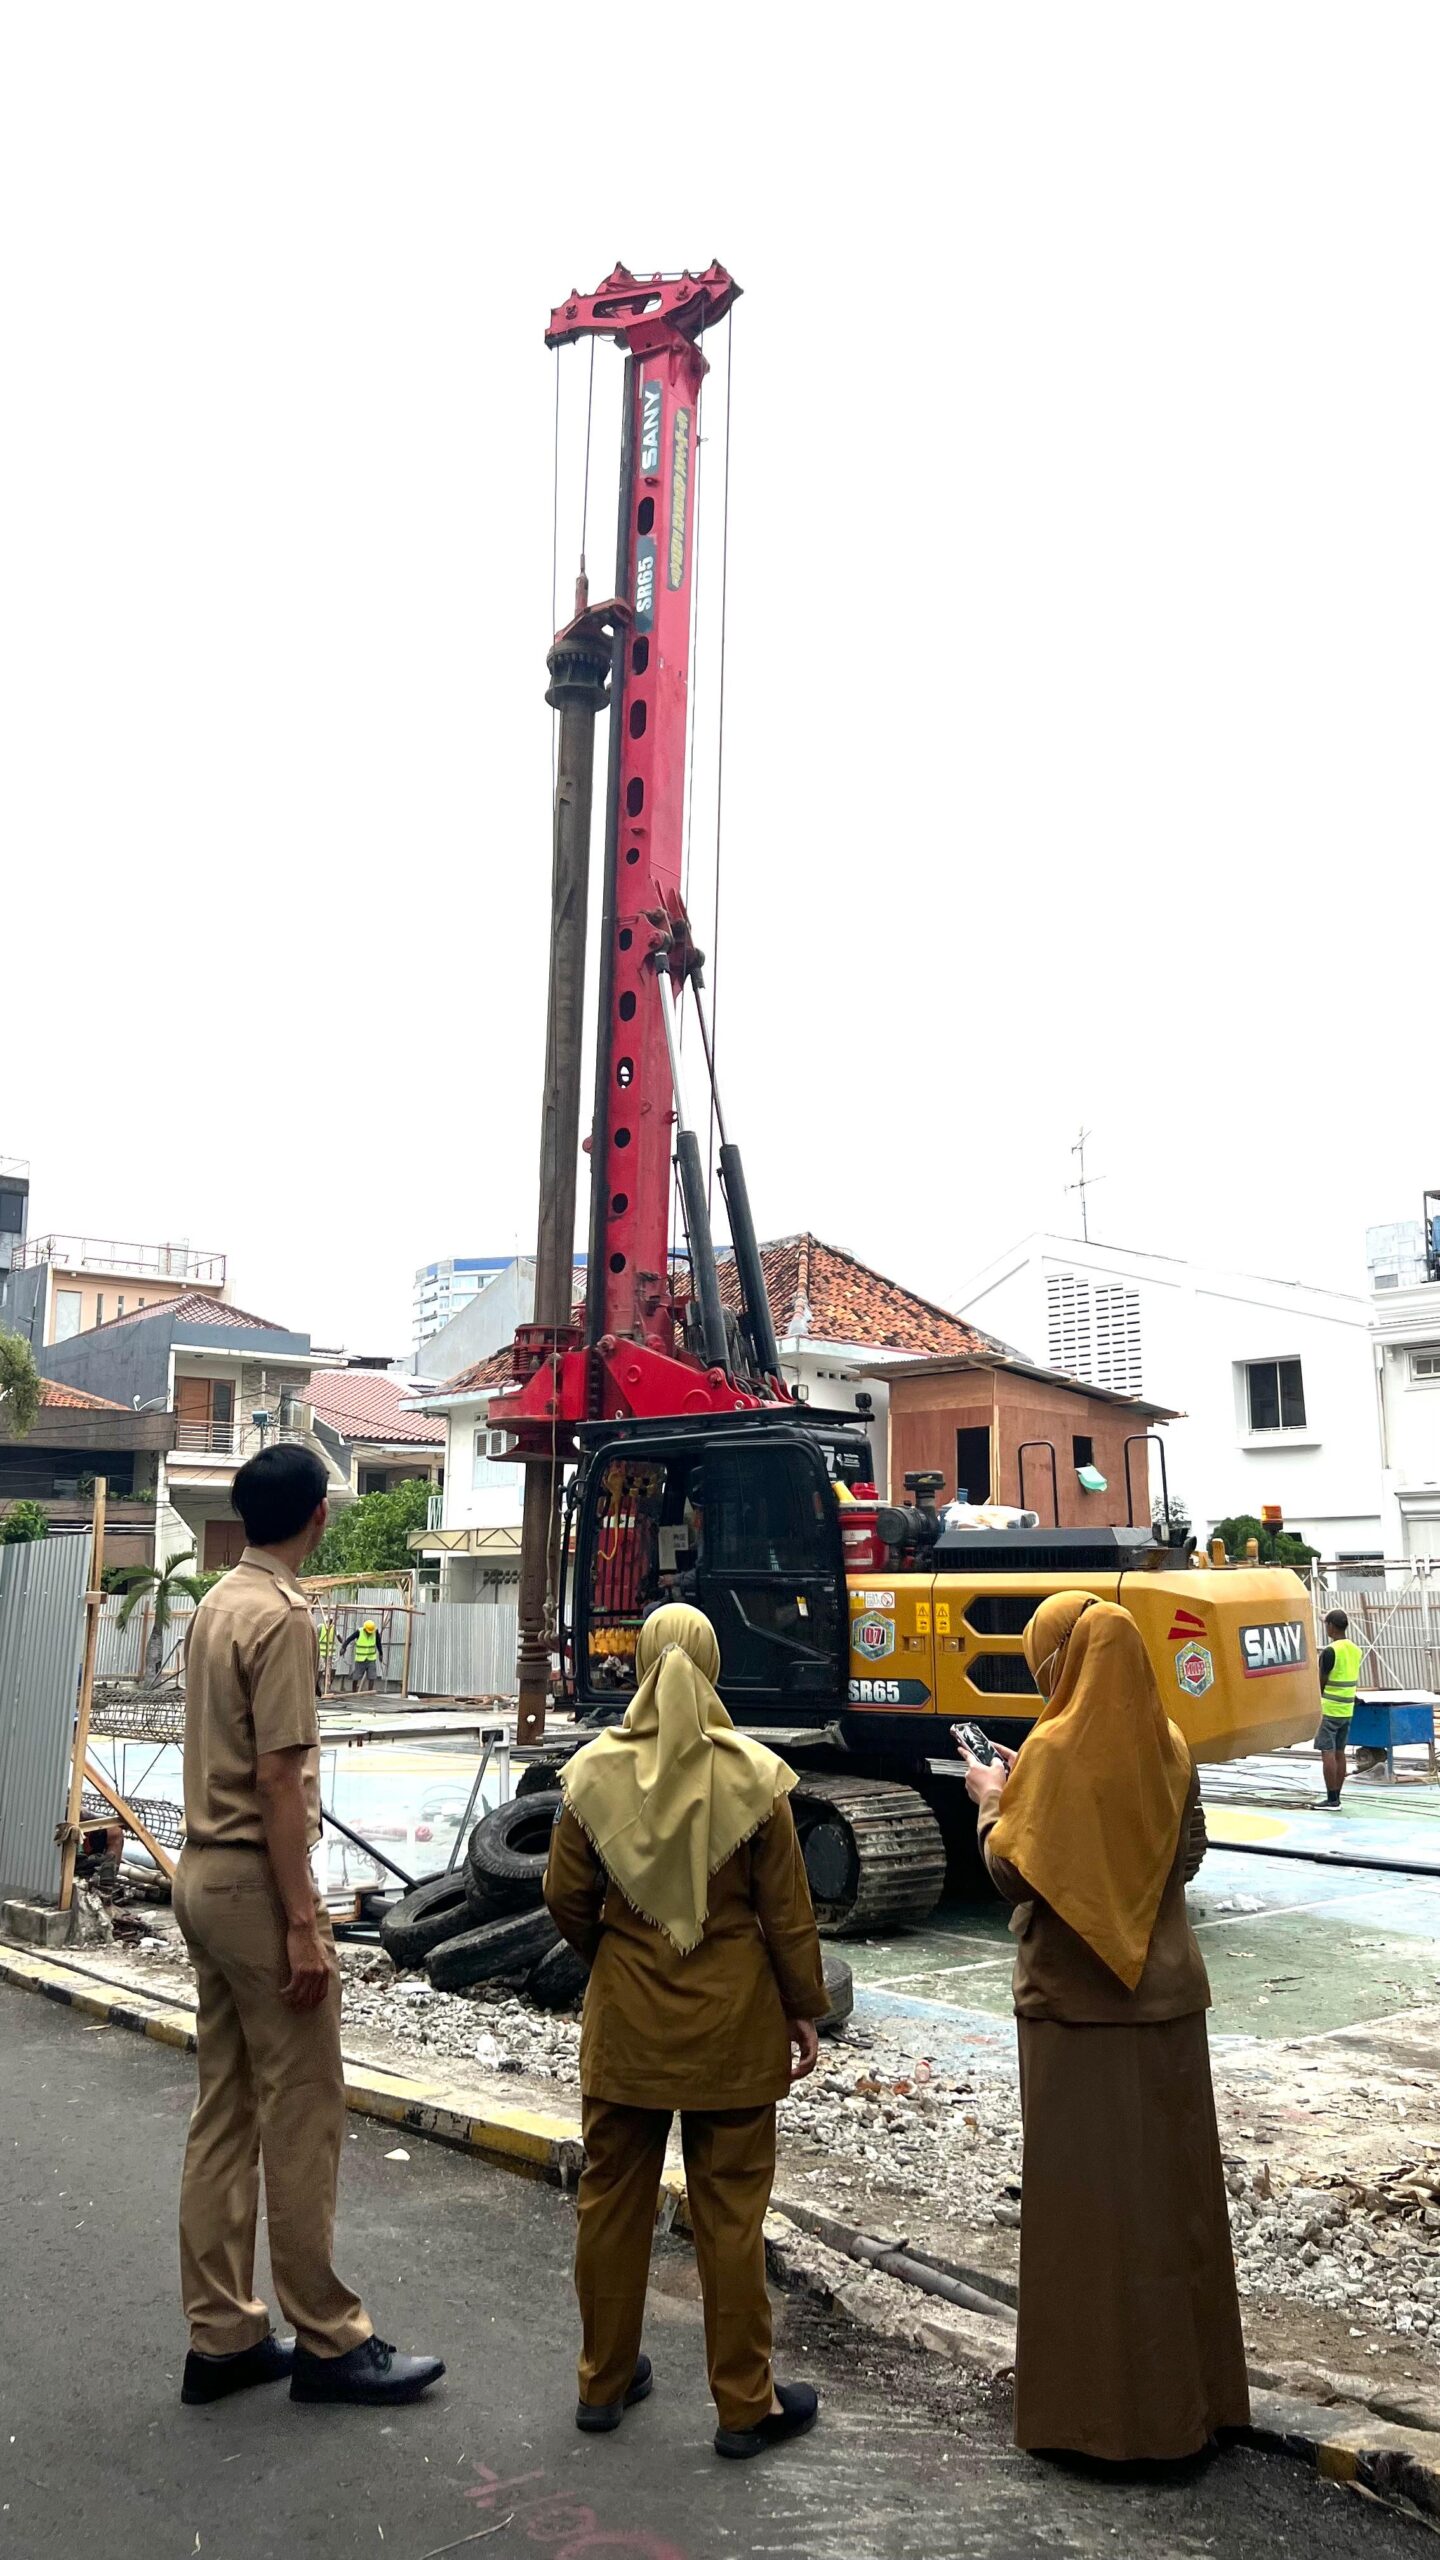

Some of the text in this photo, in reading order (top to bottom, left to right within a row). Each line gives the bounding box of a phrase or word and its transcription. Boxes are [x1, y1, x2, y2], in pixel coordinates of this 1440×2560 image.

[641, 390, 661, 470] SANY
[636, 556, 654, 613] SR65
[865, 1627, 883, 1646] 07
[1244, 1624, 1301, 1668] SANY
[848, 1679, 900, 1704] SR65
